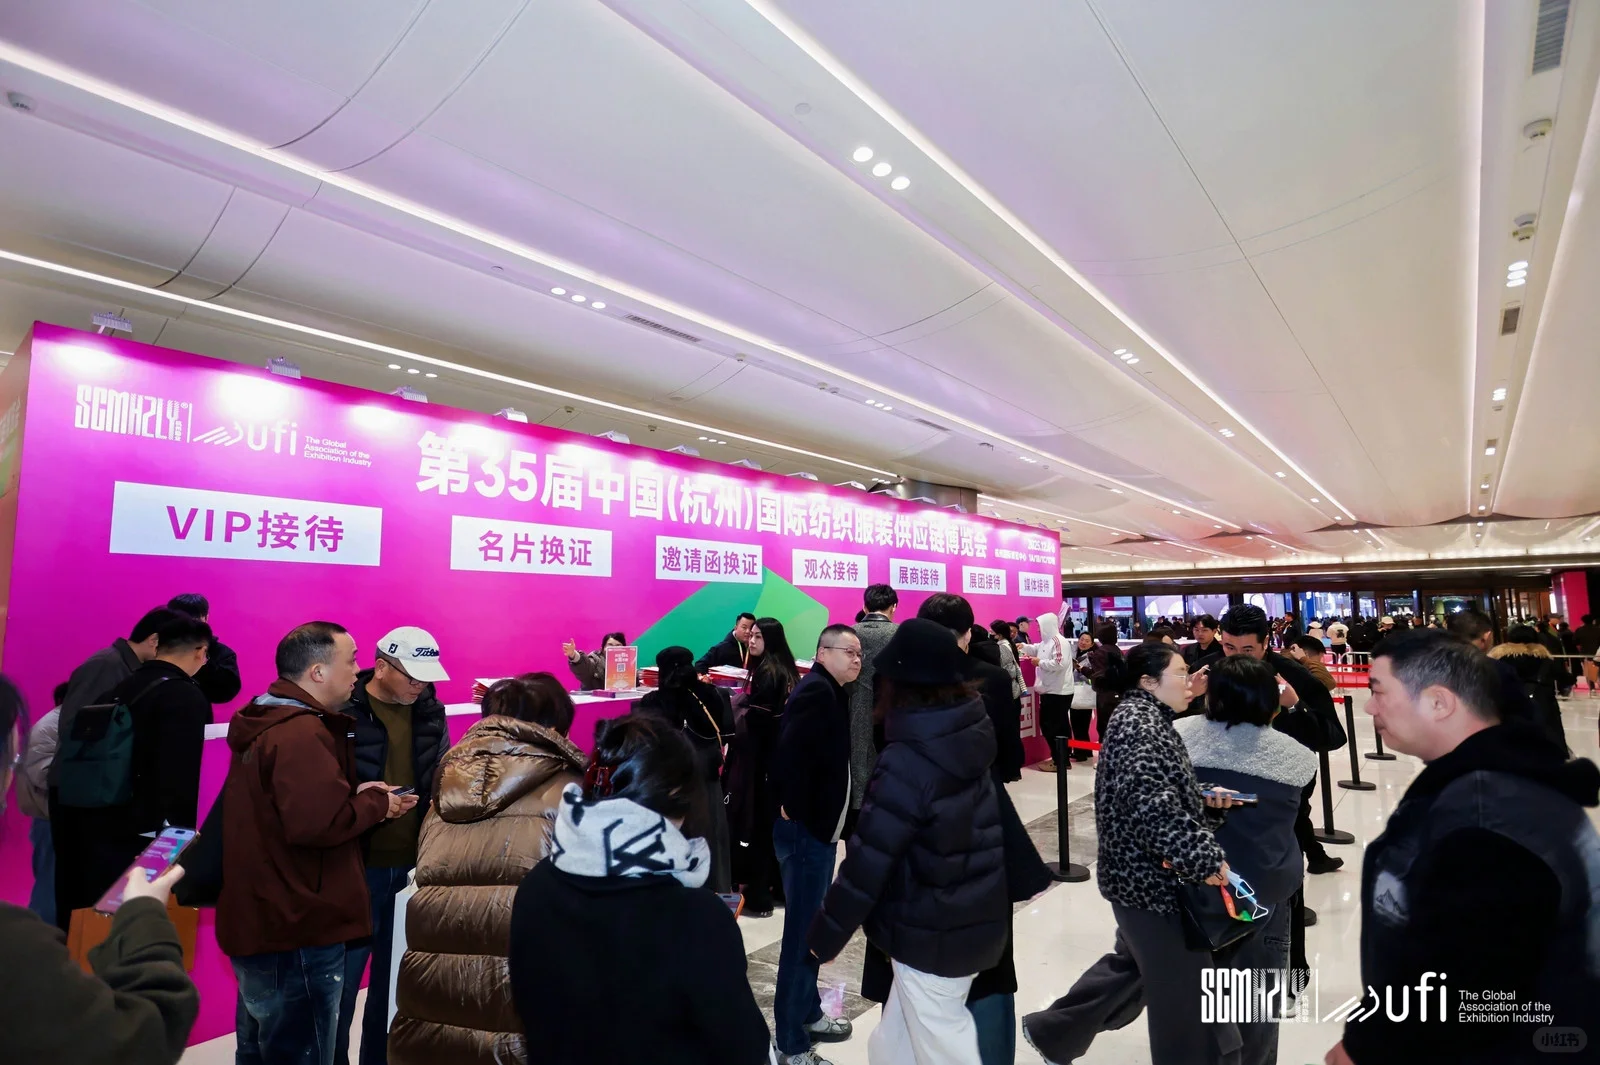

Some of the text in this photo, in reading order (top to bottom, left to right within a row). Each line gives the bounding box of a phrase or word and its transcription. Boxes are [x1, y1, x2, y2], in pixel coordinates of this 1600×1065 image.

[247, 419, 298, 456] ufi
[304, 435, 347, 449] The Global
[304, 444, 370, 460] Association of the
[304, 451, 372, 467] Exhibition Industry
[166, 505, 344, 553] VIP接待
[478, 530, 593, 567] 名片换证
[662, 546, 758, 576] 邀请函换证
[804, 558, 859, 582] 观众接待
[899, 566, 940, 587] 展商接待
[969, 572, 1001, 591] 展团接待
[1024, 576, 1050, 593] 媒体接待
